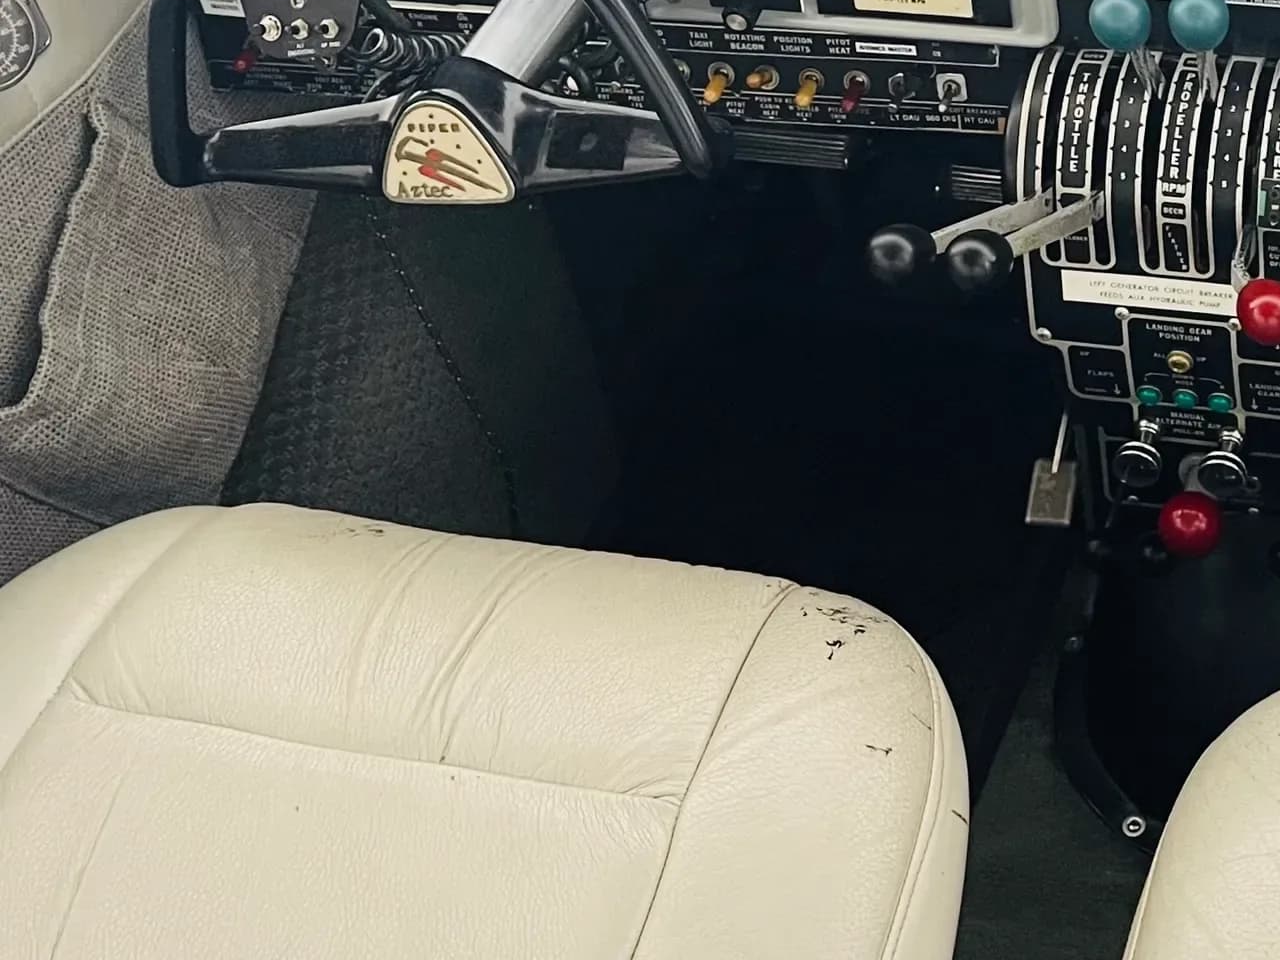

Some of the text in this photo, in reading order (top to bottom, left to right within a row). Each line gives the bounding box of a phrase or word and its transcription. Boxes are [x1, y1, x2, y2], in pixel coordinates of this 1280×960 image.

[689, 31, 850, 46] TAXI ROTATING POSITION PITOT
[690, 40, 713, 48] LIGHT
[730, 42, 765, 51] BEACON
[781, 45, 811, 53] LIGHTS
[407, 123, 461, 133] PIPER
[1069, 72, 1091, 173] THROTTLE
[1169, 72, 1196, 179] PROPELLER
[398, 181, 454, 198] Aztec
[1162, 183, 1186, 194] RPM
[1110, 281, 1159, 292] GENERATOR
[1164, 287, 1194, 295] CIRCUIT
[1199, 290, 1233, 299] BREAKER
[1099, 291, 1124, 299] FEEDS
[1149, 295, 1193, 306] HYDRAULIC
[1146, 323, 1212, 336] LANDING GEAR
[1158, 332, 1201, 342] POSITION
[1087, 369, 1114, 377] FLAPS
[1257, 390, 1280, 398] GEAR
[1170, 411, 1205, 421] MANUAL
[1154, 417, 1203, 429] ALTERNATE
